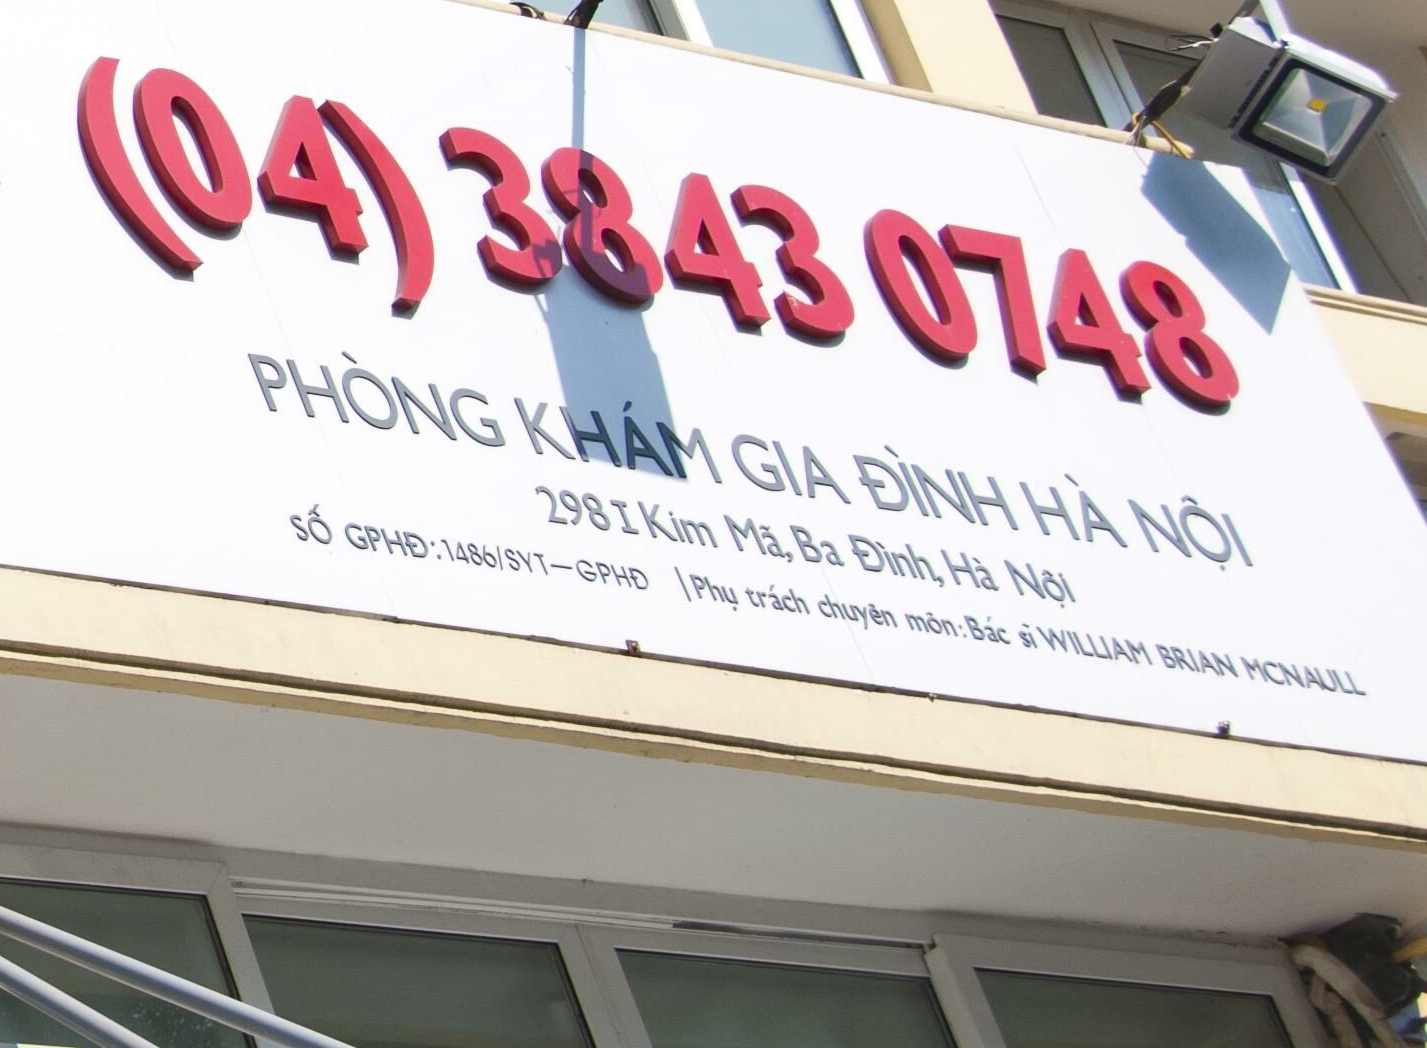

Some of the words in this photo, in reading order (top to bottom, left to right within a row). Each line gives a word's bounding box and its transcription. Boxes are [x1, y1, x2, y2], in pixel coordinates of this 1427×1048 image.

[78, 56, 435, 309] (04)
[439, 126, 855, 339] 3843
[864, 208, 1240, 407] 0748
[248, 351, 505, 447] PHÒNG
[514, 401, 722, 484] KHÁM
[731, 433, 851, 504] GIA
[853, 445, 1019, 530] ĐÌNH
[1019, 473, 1128, 549] HÀ
[1128, 494, 1253, 571] NỘI
[637, 501, 718, 548] Kim
[790, 525, 844, 567] Ba
[941, 549, 999, 591] Hà
[1004, 559, 1075, 608] Nội
[290, 503, 333, 545] SỐ
[1036, 626, 1153, 665] WILLIAM
[1156, 643, 1239, 678] BRIAN
[1241, 656, 1366, 696] MCNAULL
